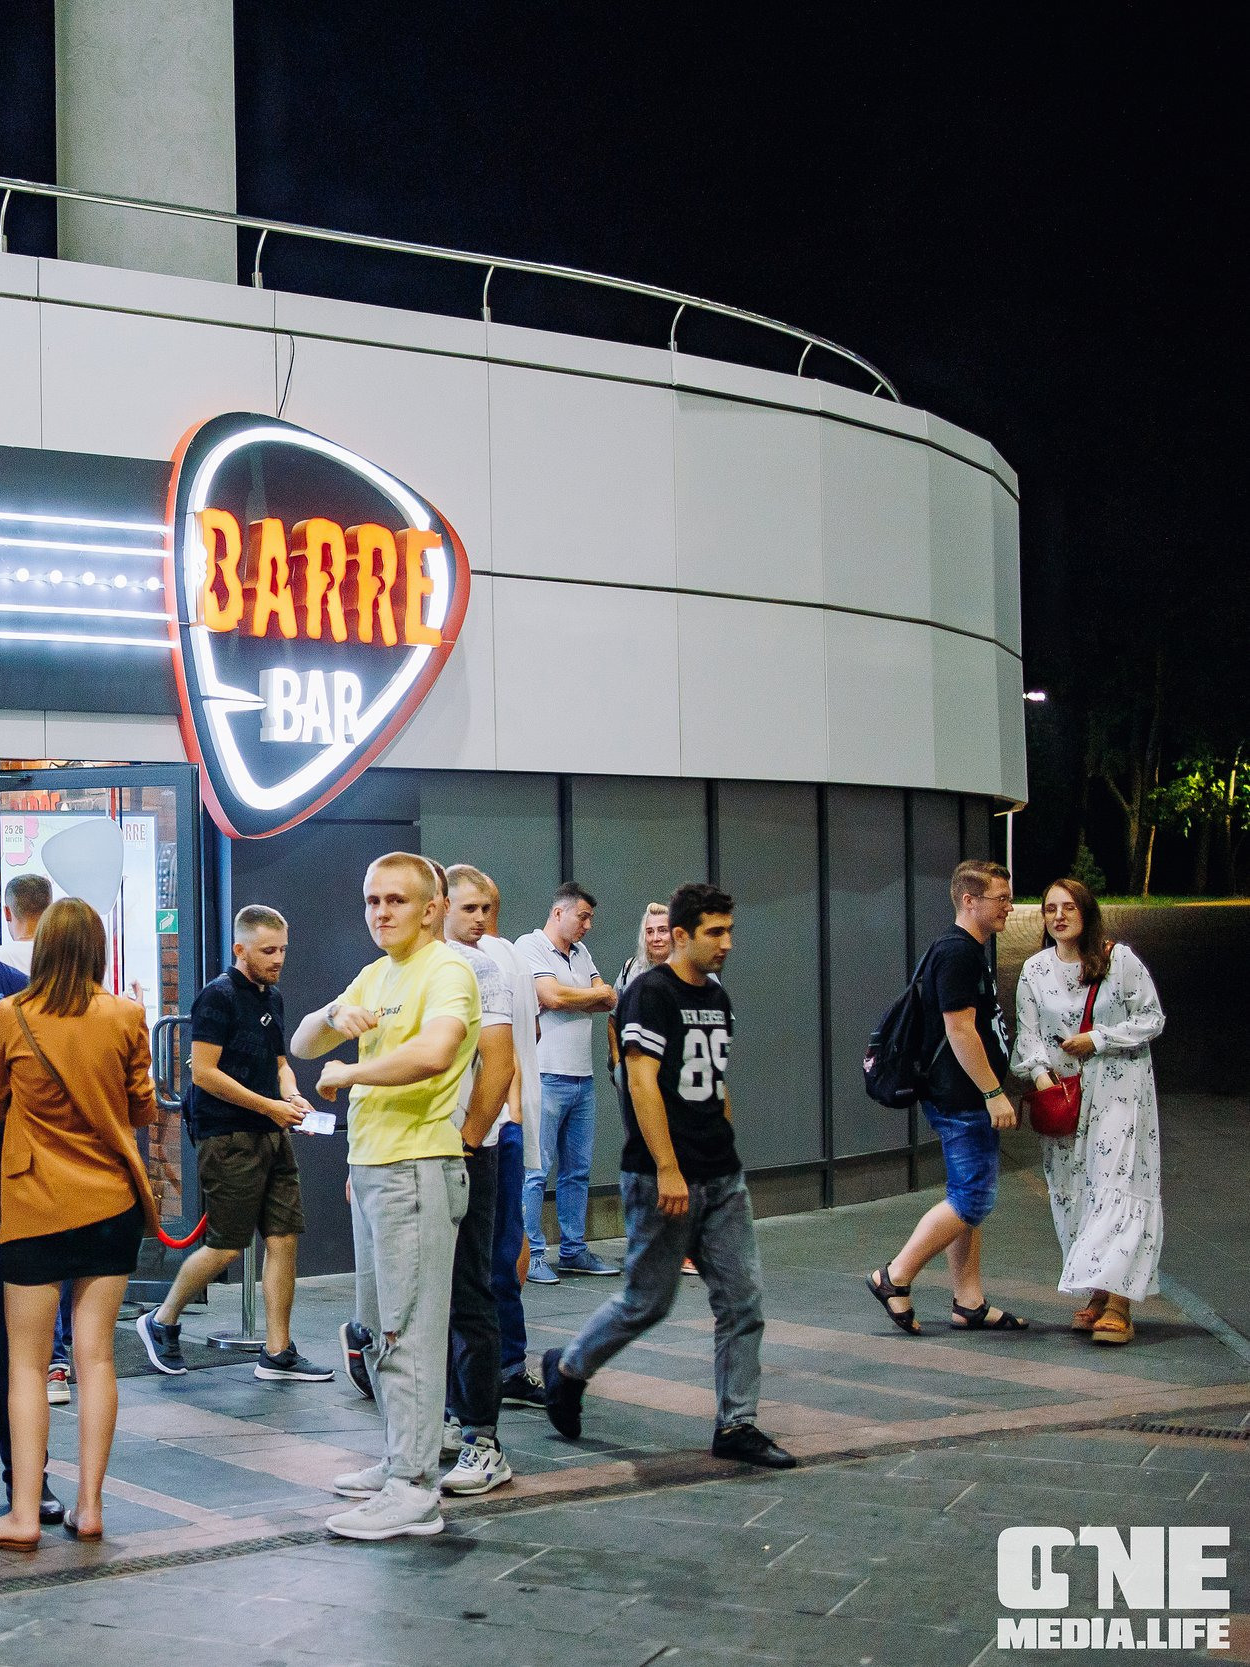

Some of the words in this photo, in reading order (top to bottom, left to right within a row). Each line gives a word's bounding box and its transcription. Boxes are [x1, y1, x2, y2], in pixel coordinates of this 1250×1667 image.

[199, 507, 443, 647] BARRE
[264, 668, 363, 744] BAR
[125, 824, 146, 841] RRE
